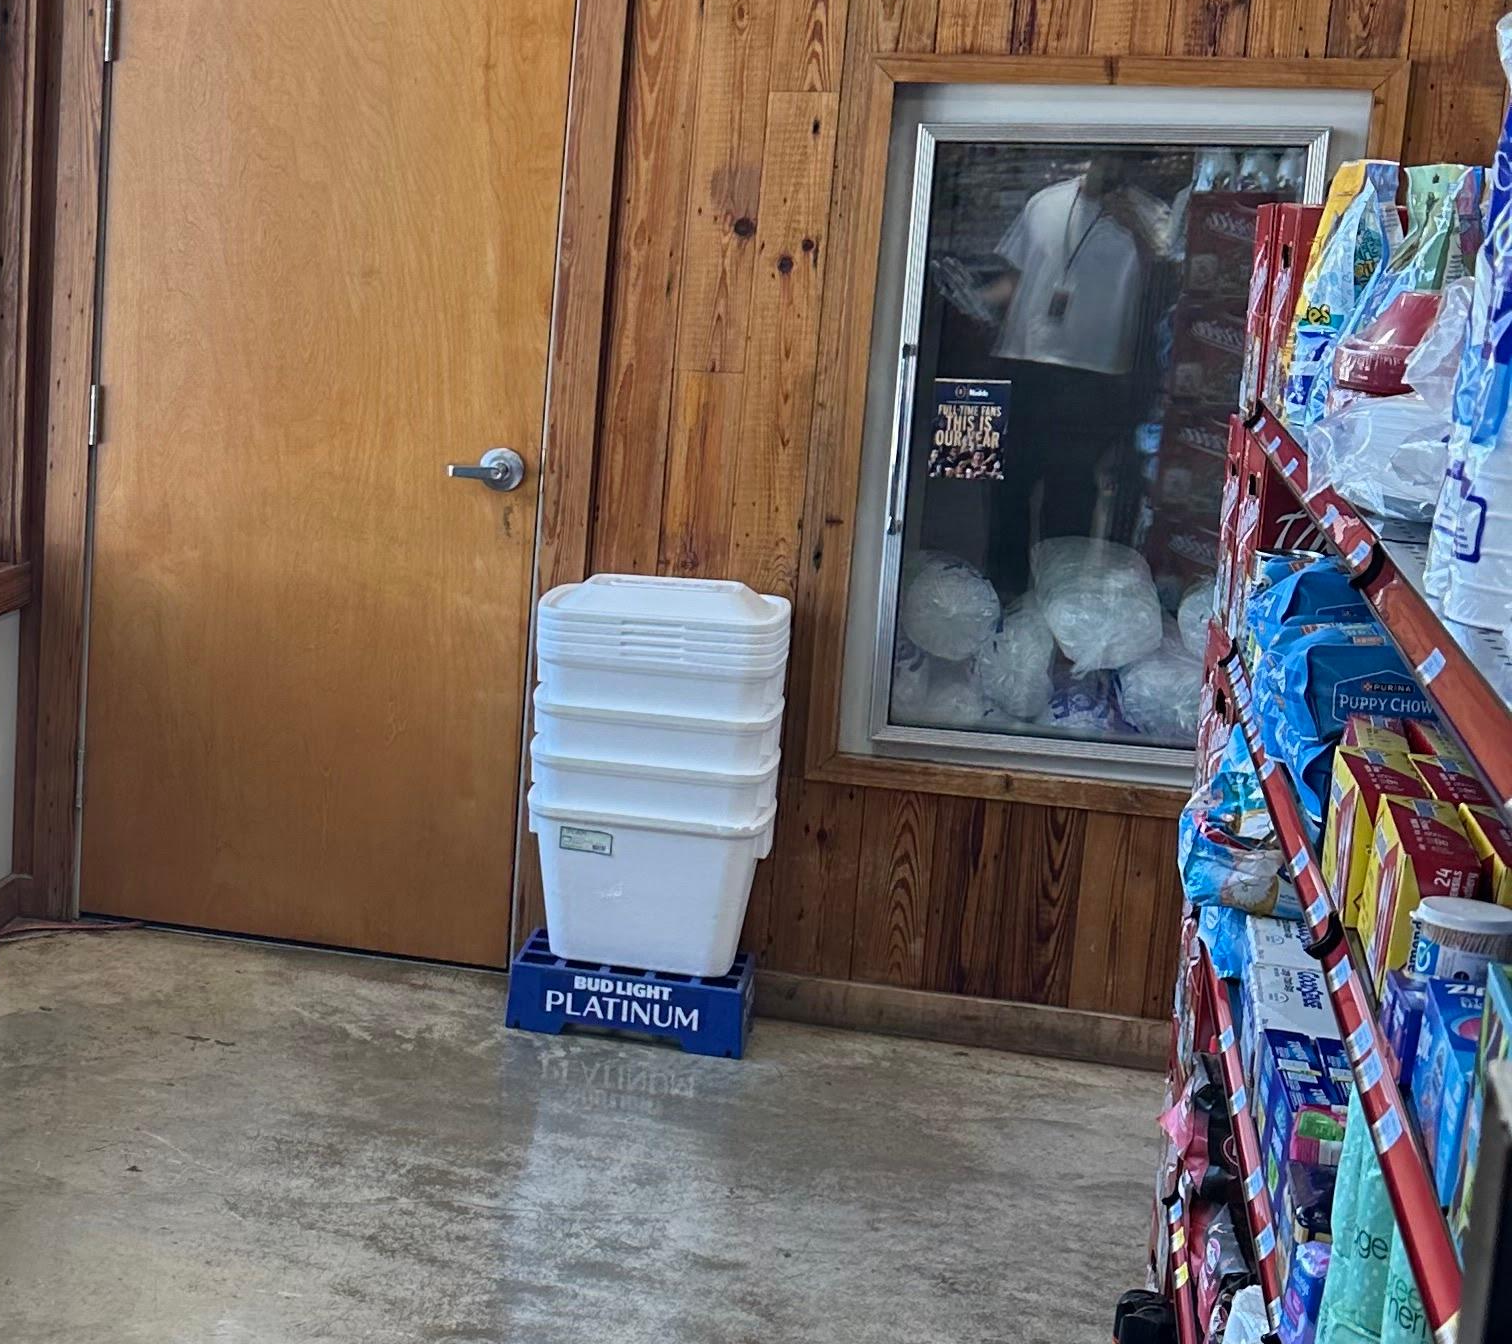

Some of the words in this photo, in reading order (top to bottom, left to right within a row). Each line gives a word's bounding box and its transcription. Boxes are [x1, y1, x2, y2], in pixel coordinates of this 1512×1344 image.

[946, 415, 975, 431] THIS
[980, 416, 993, 432] IS
[935, 430, 963, 446] OUR
[1374, 683, 1411, 693] PURINA
[1339, 694, 1388, 711] PUPPY
[1390, 698, 1435, 714] CHOW
[1433, 868, 1453, 887] 24
[574, 975, 615, 994] BUD
[615, 981, 673, 1001] LIGHT
[545, 990, 700, 1032] PLATINUM
